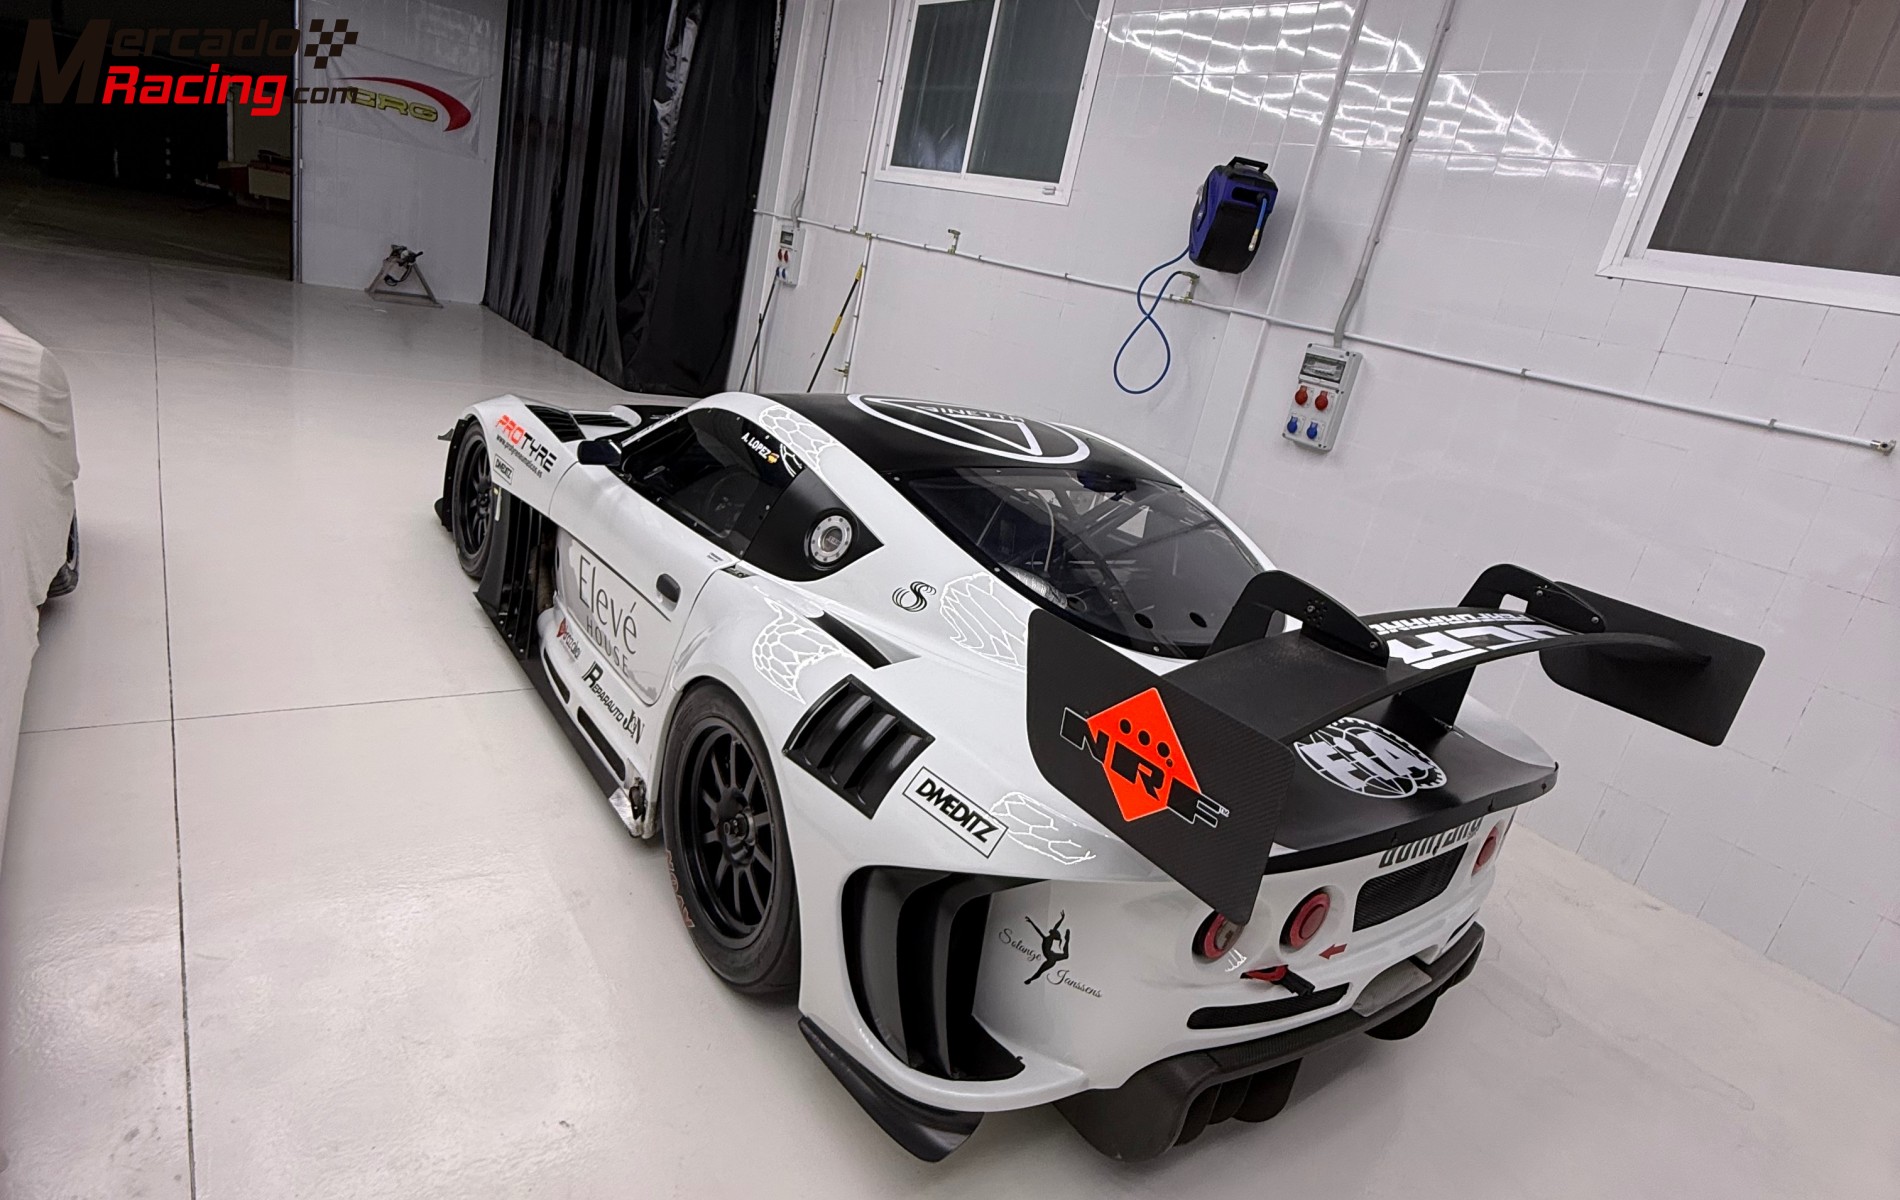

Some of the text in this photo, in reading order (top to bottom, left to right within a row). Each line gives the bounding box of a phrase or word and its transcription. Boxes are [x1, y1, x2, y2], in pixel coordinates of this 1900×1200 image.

[496, 414, 557, 473] PROTYRE
[747, 436, 772, 460] LOPEZ
[579, 554, 637, 655] Elevé
[1368, 612, 1536, 636] PERFORMANC
[586, 615, 630, 679] HOUSE
[915, 778, 998, 843] DMEDITZ
[998, 928, 1041, 961] Solange
[1046, 969, 1102, 998] Janssens
